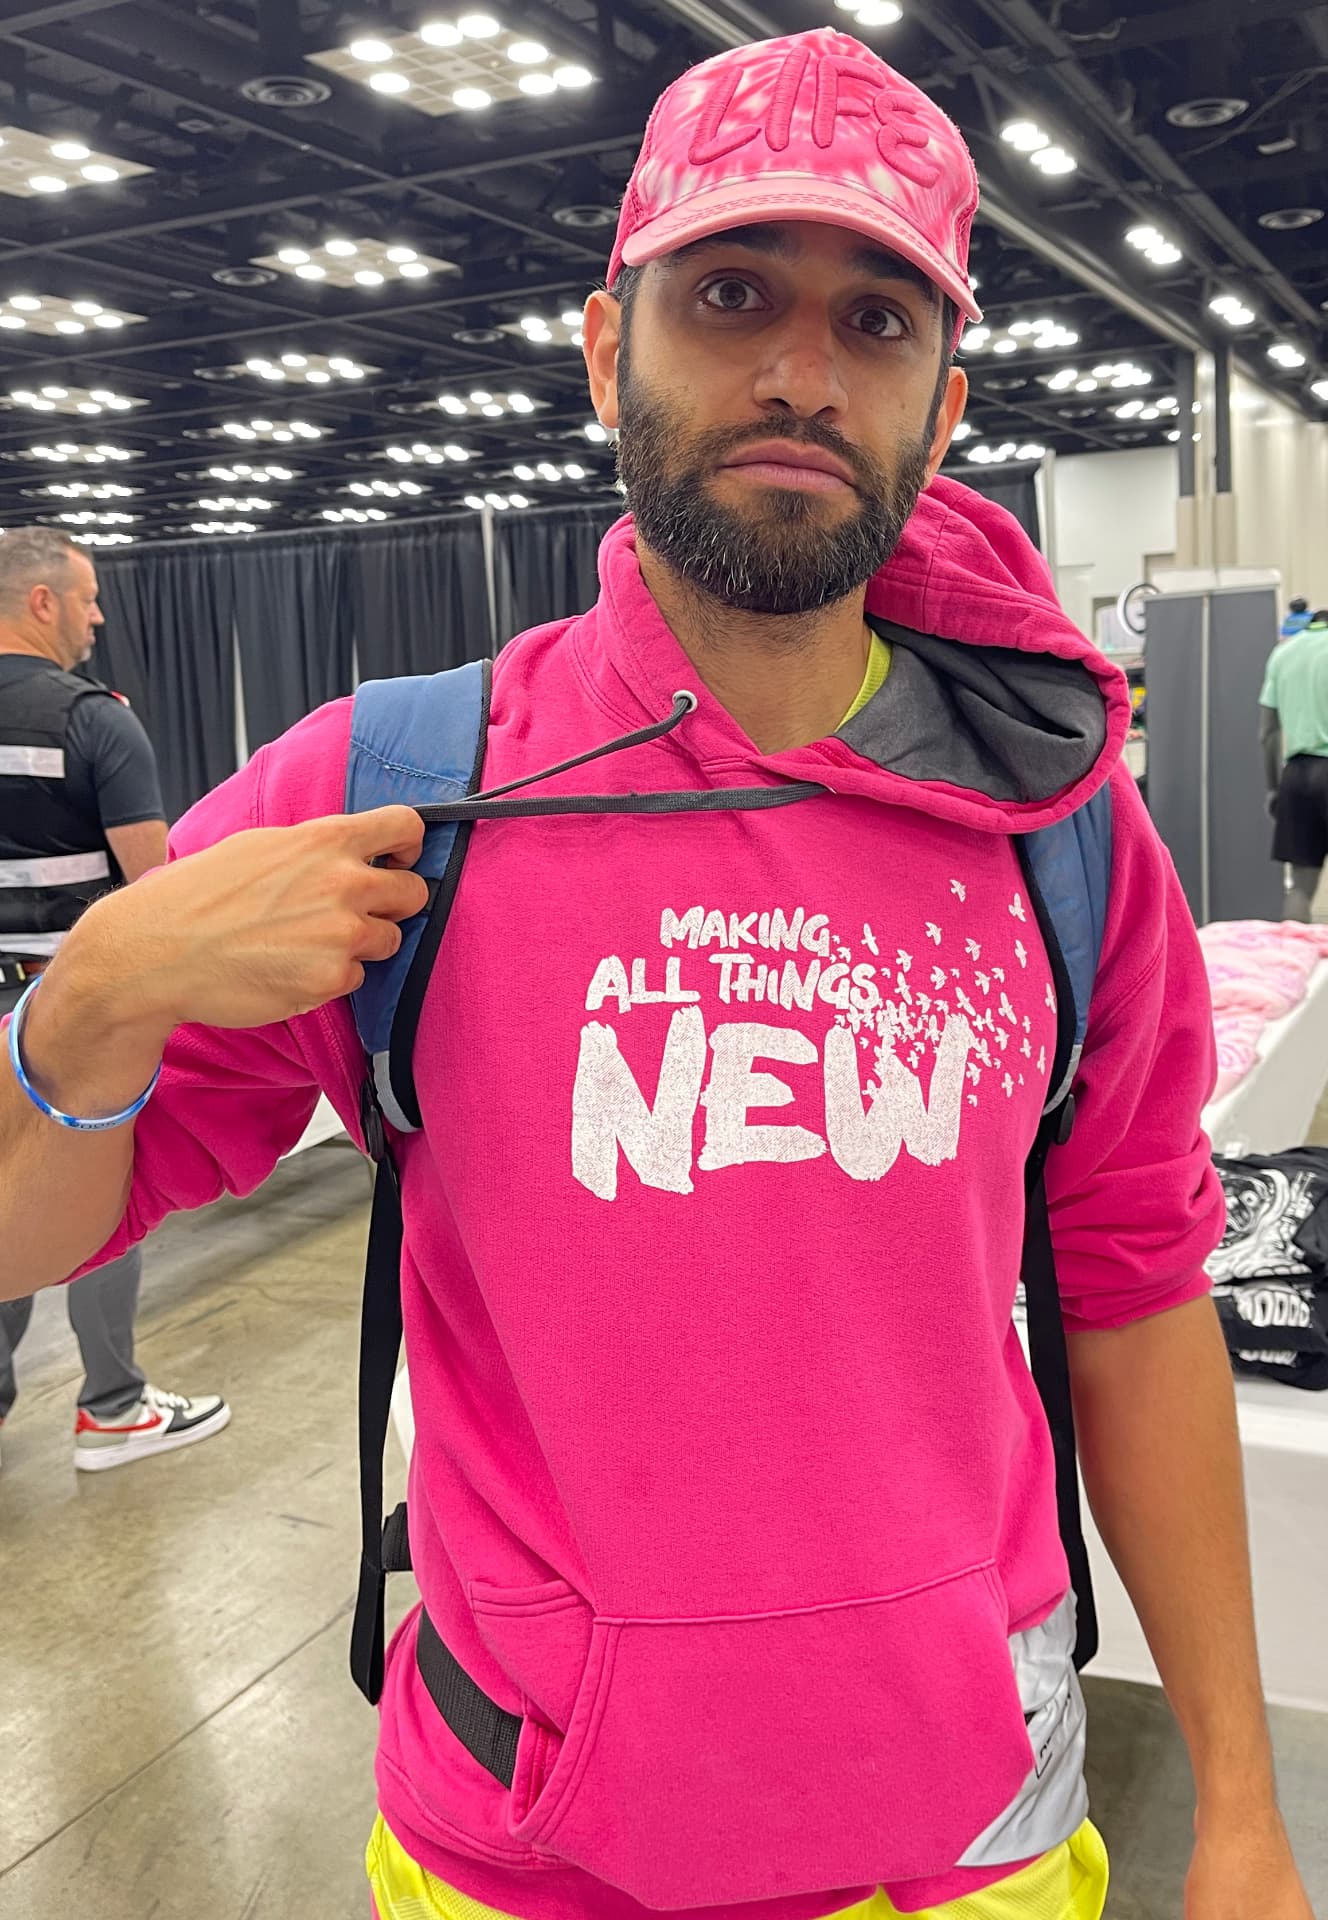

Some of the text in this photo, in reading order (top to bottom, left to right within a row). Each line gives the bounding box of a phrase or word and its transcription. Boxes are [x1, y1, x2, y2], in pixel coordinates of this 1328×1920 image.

[687, 47, 941, 189] LIFE
[660, 905, 831, 957] MAKING
[585, 952, 881, 1013] ALL THINGS
[571, 1004, 973, 1201] NEW
